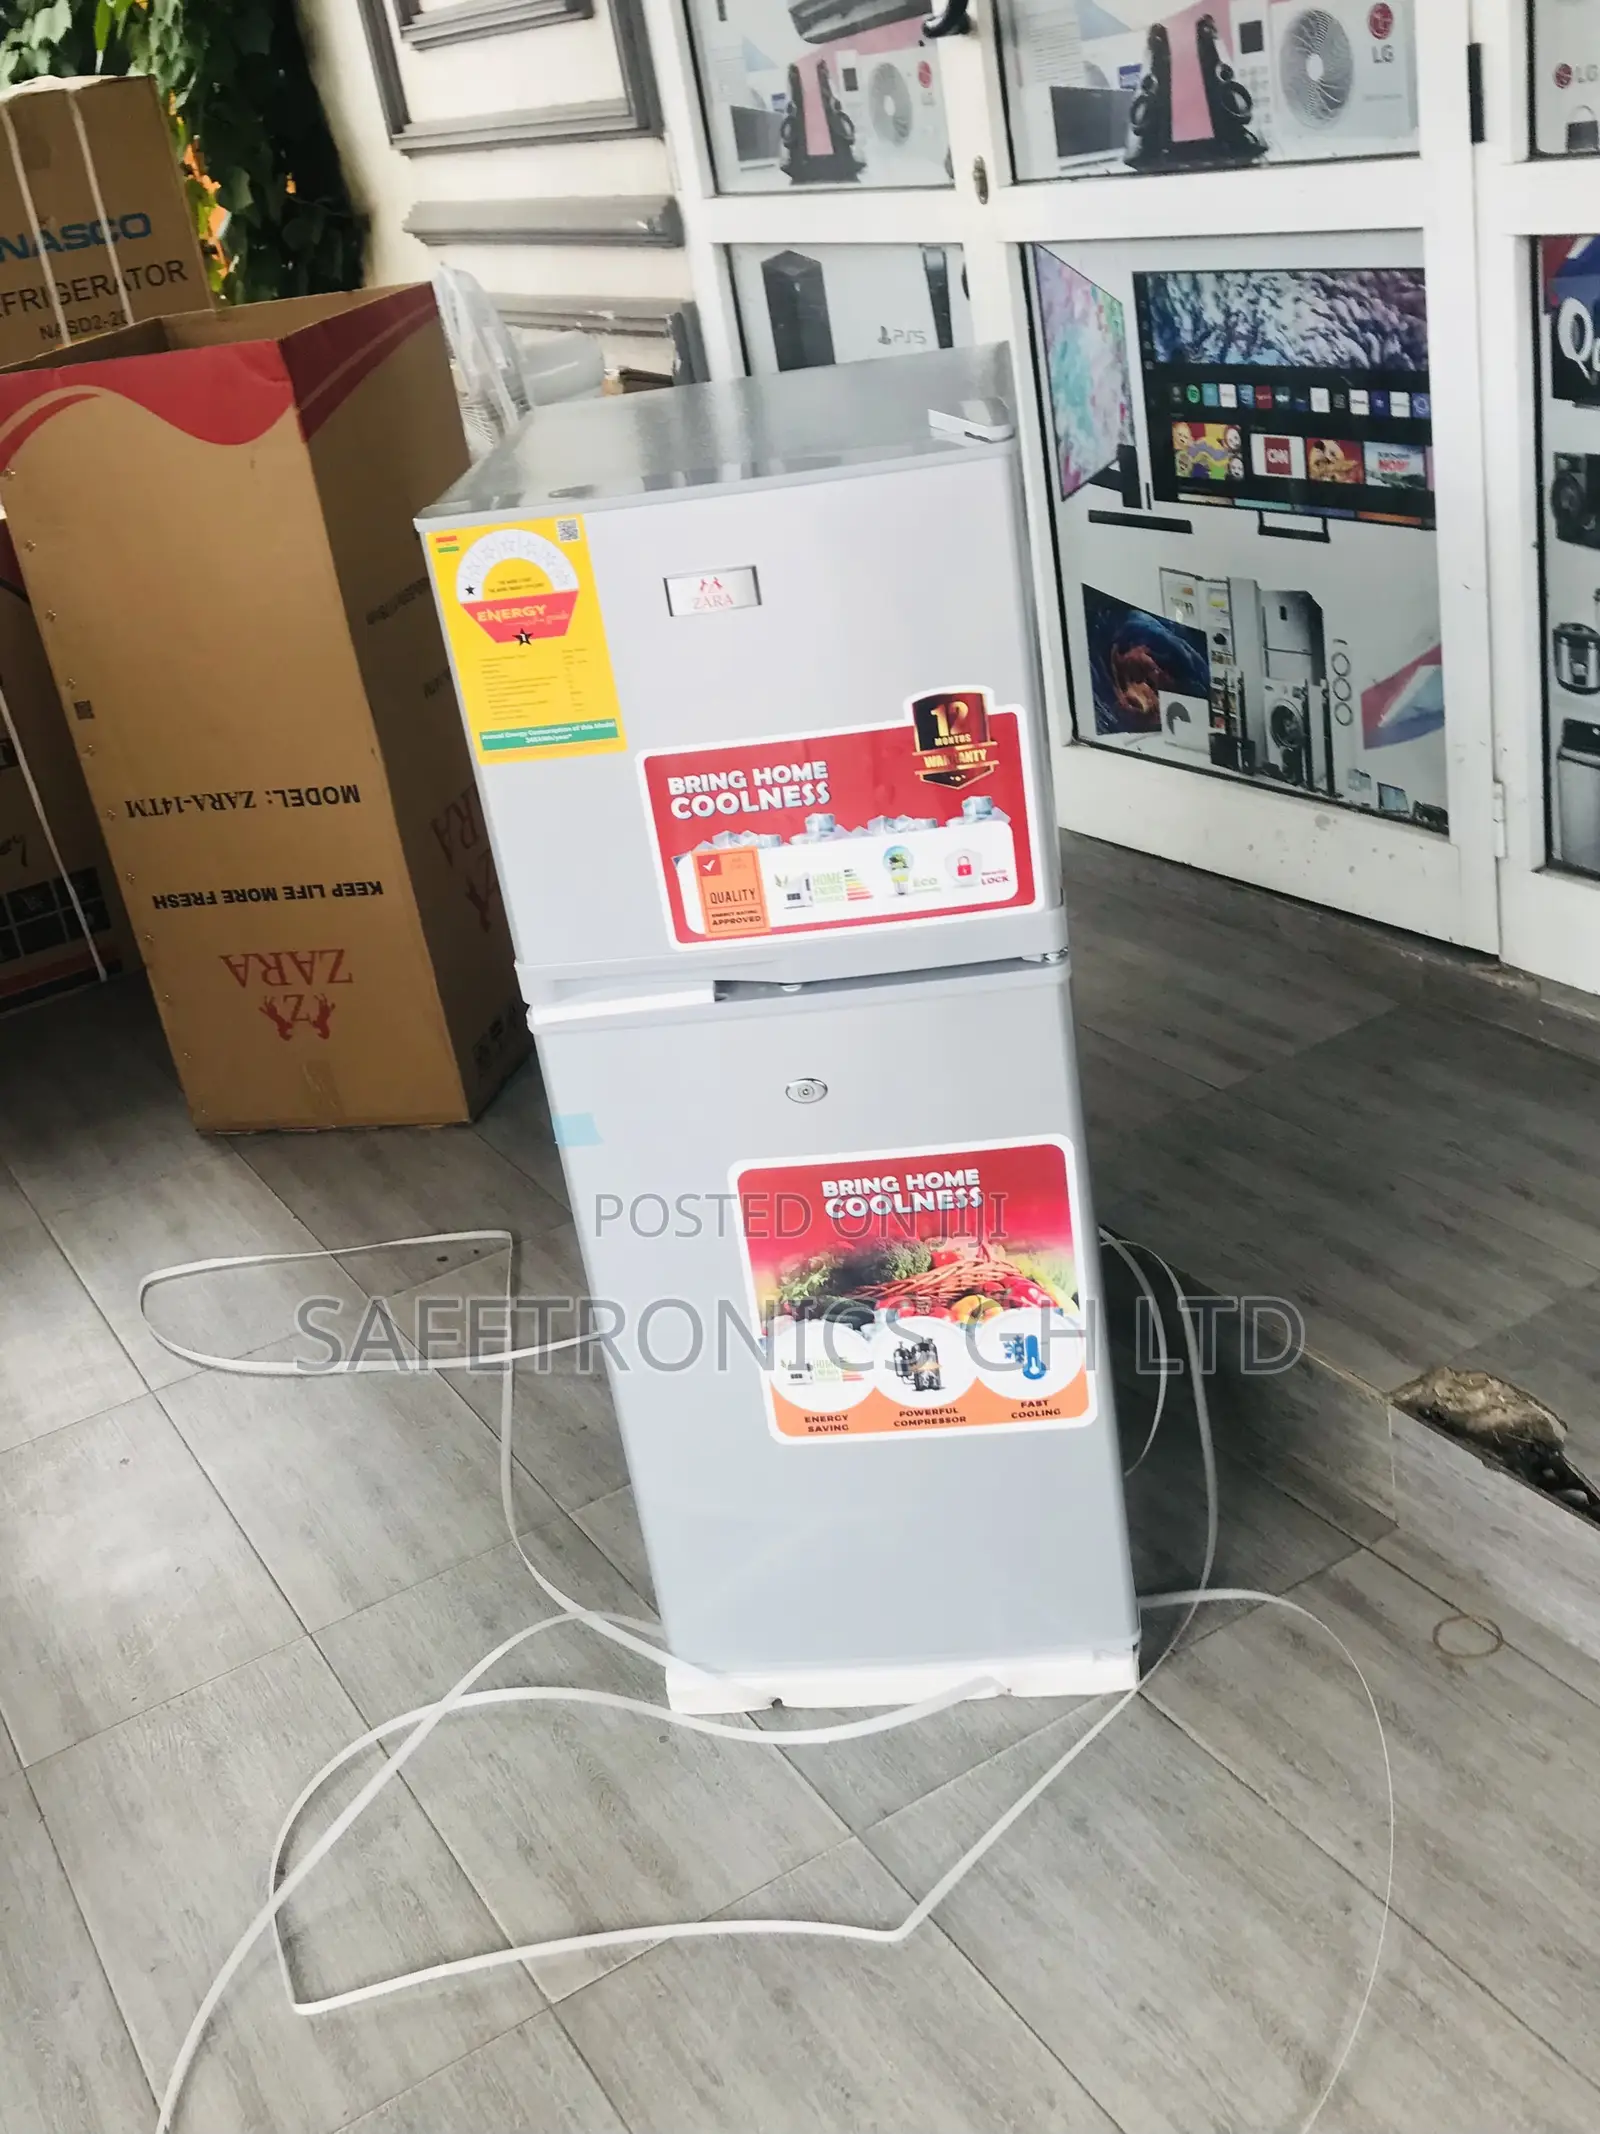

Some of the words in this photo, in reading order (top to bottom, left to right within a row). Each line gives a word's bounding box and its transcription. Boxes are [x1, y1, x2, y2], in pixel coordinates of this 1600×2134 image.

[1371, 44, 1394, 64] LG
[1575, 64, 1599, 84] LG
[0, 212, 152, 262] NASCO
[0, 260, 188, 318] FRIGERATOR
[477, 604, 547, 623] ENERGY
[930, 700, 969, 737] 12
[934, 734, 972, 747] MONTHS
[667, 770, 747, 797] BRING
[753, 760, 829, 785] HOME
[125, 790, 256, 819] ZARA-14TM
[265, 784, 360, 807] MODEL:
[670, 779, 831, 820] COOLNESS
[331, 881, 384, 898] KEEP
[981, 875, 1010, 886] LOCK
[152, 891, 218, 910] FRESH
[223, 887, 278, 904] MORE
[283, 884, 326, 900] LIFE
[709, 887, 757, 905] QUALITY
[711, 915, 762, 927] APPROVED
[220, 949, 353, 988] ZARA
[821, 1174, 900, 1199] BRING
[906, 1168, 980, 1190] HOME
[825, 1185, 984, 1220] COOLNESS
[898, 1407, 959, 1418] POWERFUL
[1020, 1399, 1049, 1408] FAST
[804, 1414, 849, 1424] ENERGY
[893, 1416, 967, 1427] COMPRESSOR
[1011, 1408, 1061, 1419] COOLING
[807, 1423, 850, 1433] SAVING
